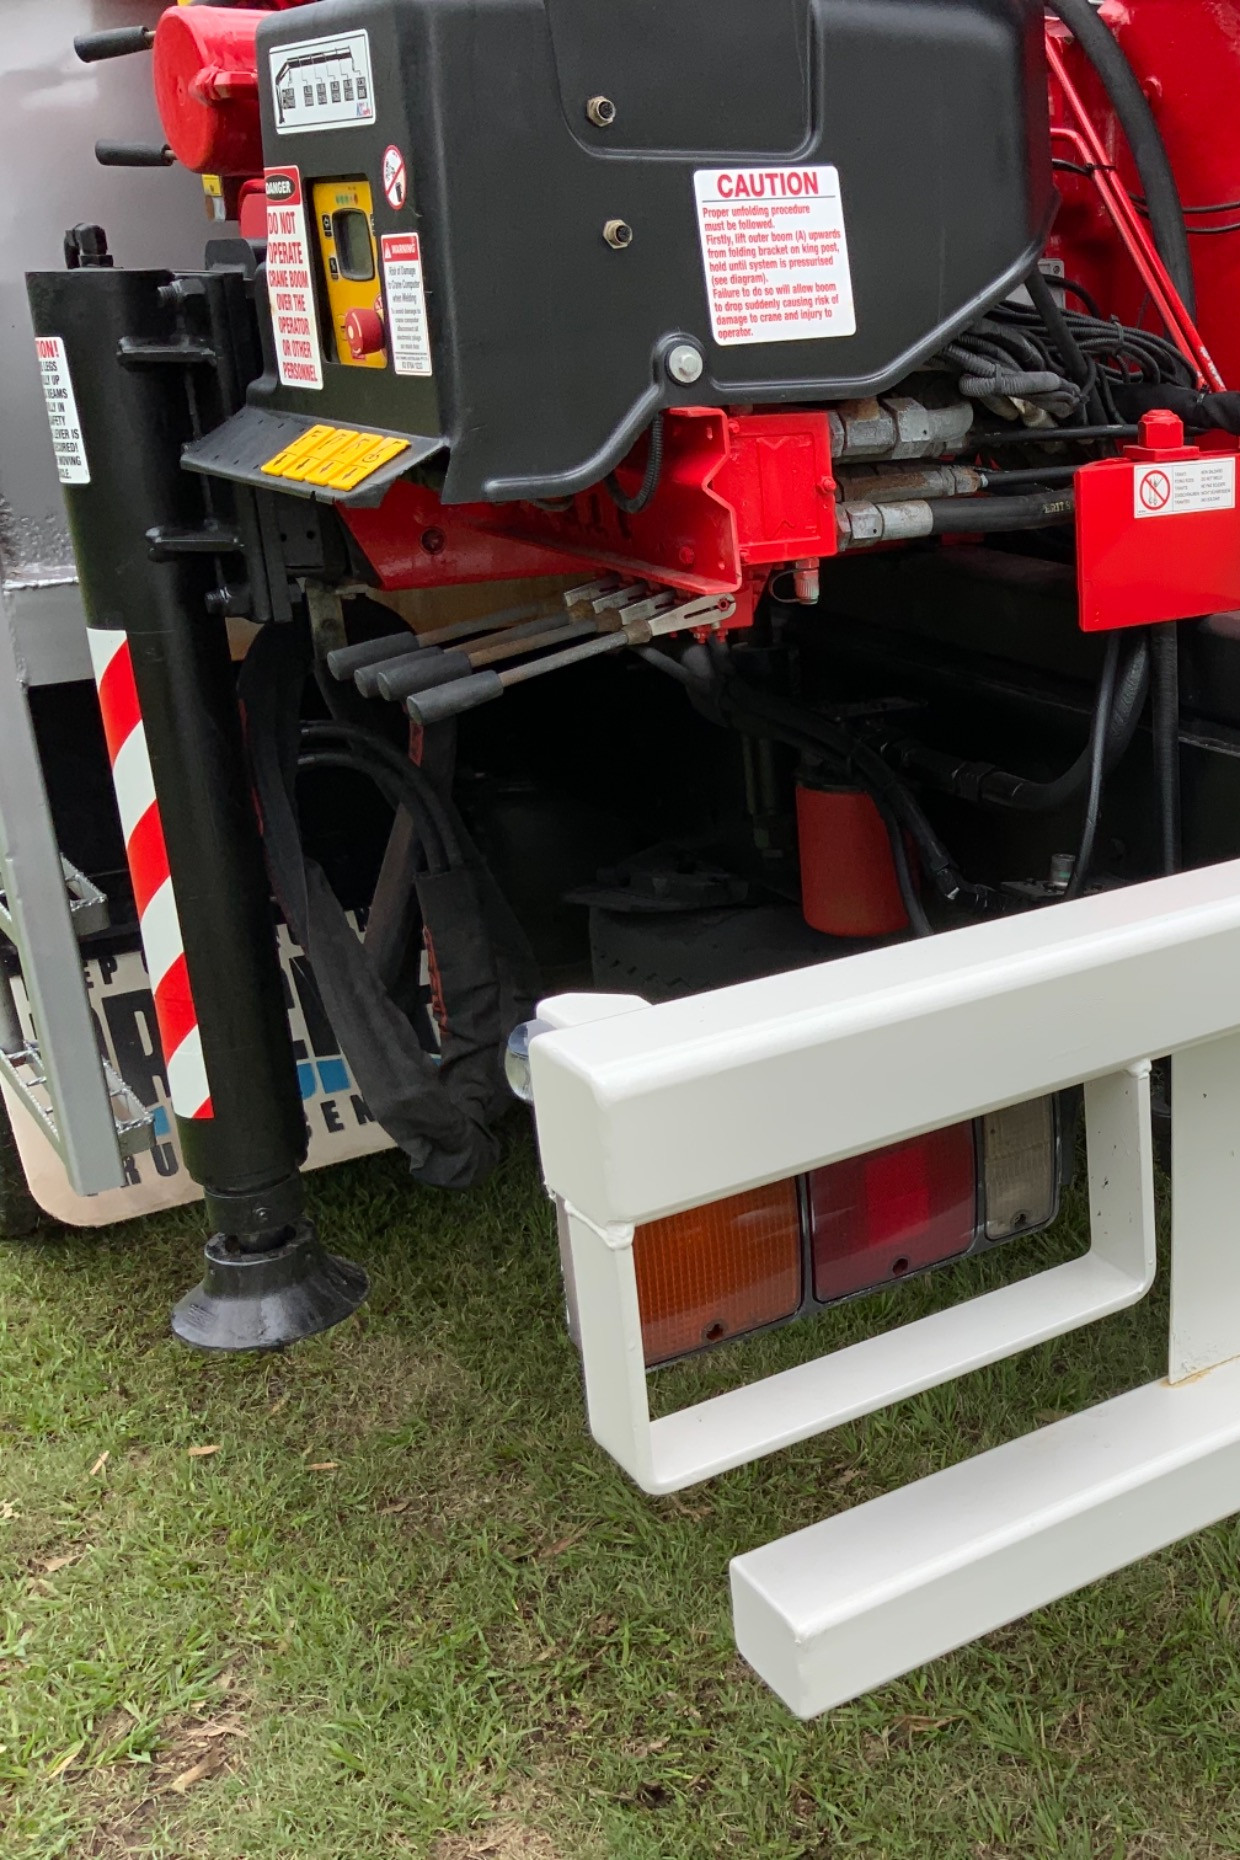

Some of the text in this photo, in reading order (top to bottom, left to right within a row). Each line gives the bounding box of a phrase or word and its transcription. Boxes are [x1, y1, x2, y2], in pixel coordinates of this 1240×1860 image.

[266, 181, 291, 194] DANGER
[717, 172, 819, 198] CAUTION
[703, 204, 810, 218] Proper unfolding procedure
[268, 211, 295, 234] DO NOT
[705, 219, 775, 231] must be followed.
[706, 229, 841, 246] Firstly, lift outer boom (A) upwards
[268, 242, 303, 264] OPERATE
[708, 243, 839, 258] from folding bracket on king post,
[710, 256, 833, 272] hold until system is pressurised
[269, 270, 309, 288] CRANE BOOM
[712, 273, 768, 287] (see diagram).
[713, 283, 836, 298] Failure to do so will allow boom
[277, 294, 306, 311] OVER THE
[715, 294, 839, 312] to drop suddenly causing risk of
[278, 316, 310, 335] OPERATOR
[717, 308, 832, 326] damage to crane and injury to
[718, 328, 753, 339] operator.
[282, 339, 312, 358] OR OTHER
[52, 375, 60, 385] UP
[283, 362, 318, 381] PERSONNEL
[71, 429, 79, 439] IS
